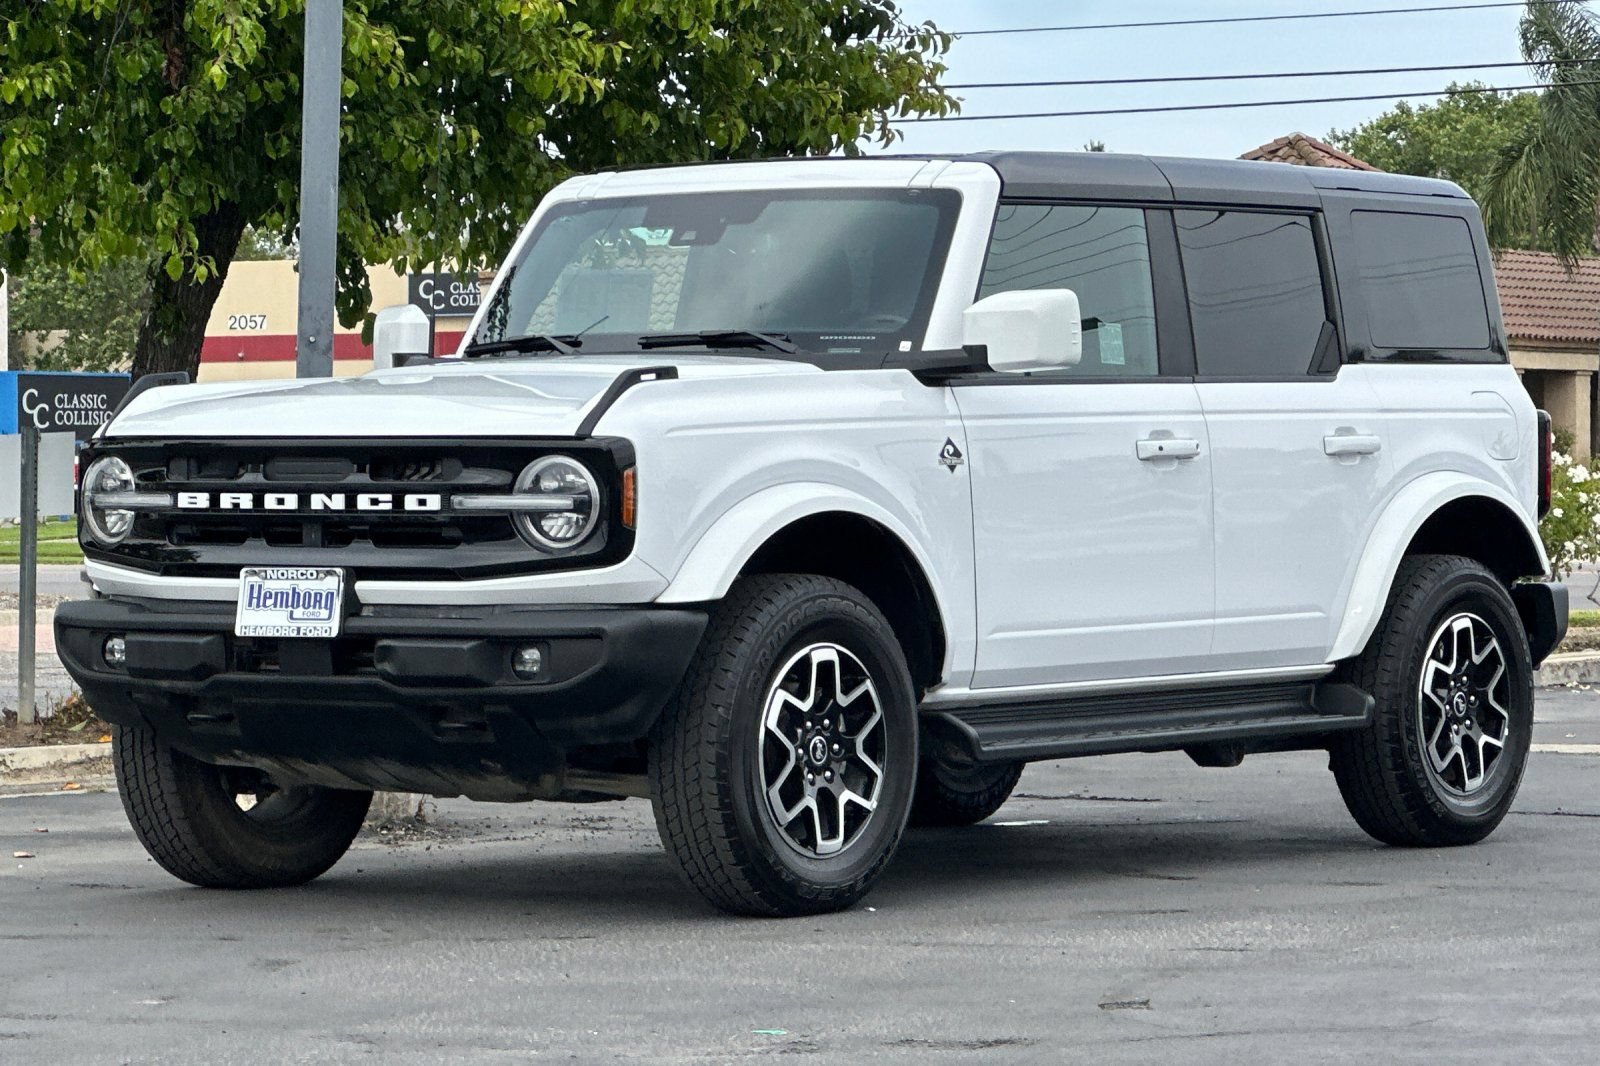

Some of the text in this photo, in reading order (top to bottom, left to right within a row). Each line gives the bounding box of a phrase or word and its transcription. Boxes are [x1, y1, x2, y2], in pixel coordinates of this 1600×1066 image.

[229, 315, 267, 330] 2057
[54, 393, 107, 410] CLASSIC
[177, 492, 441, 511] BRONCO
[266, 569, 317, 580] NORCO
[302, 610, 321, 618] FORD
[241, 626, 331, 637] HEMBORG FORD
